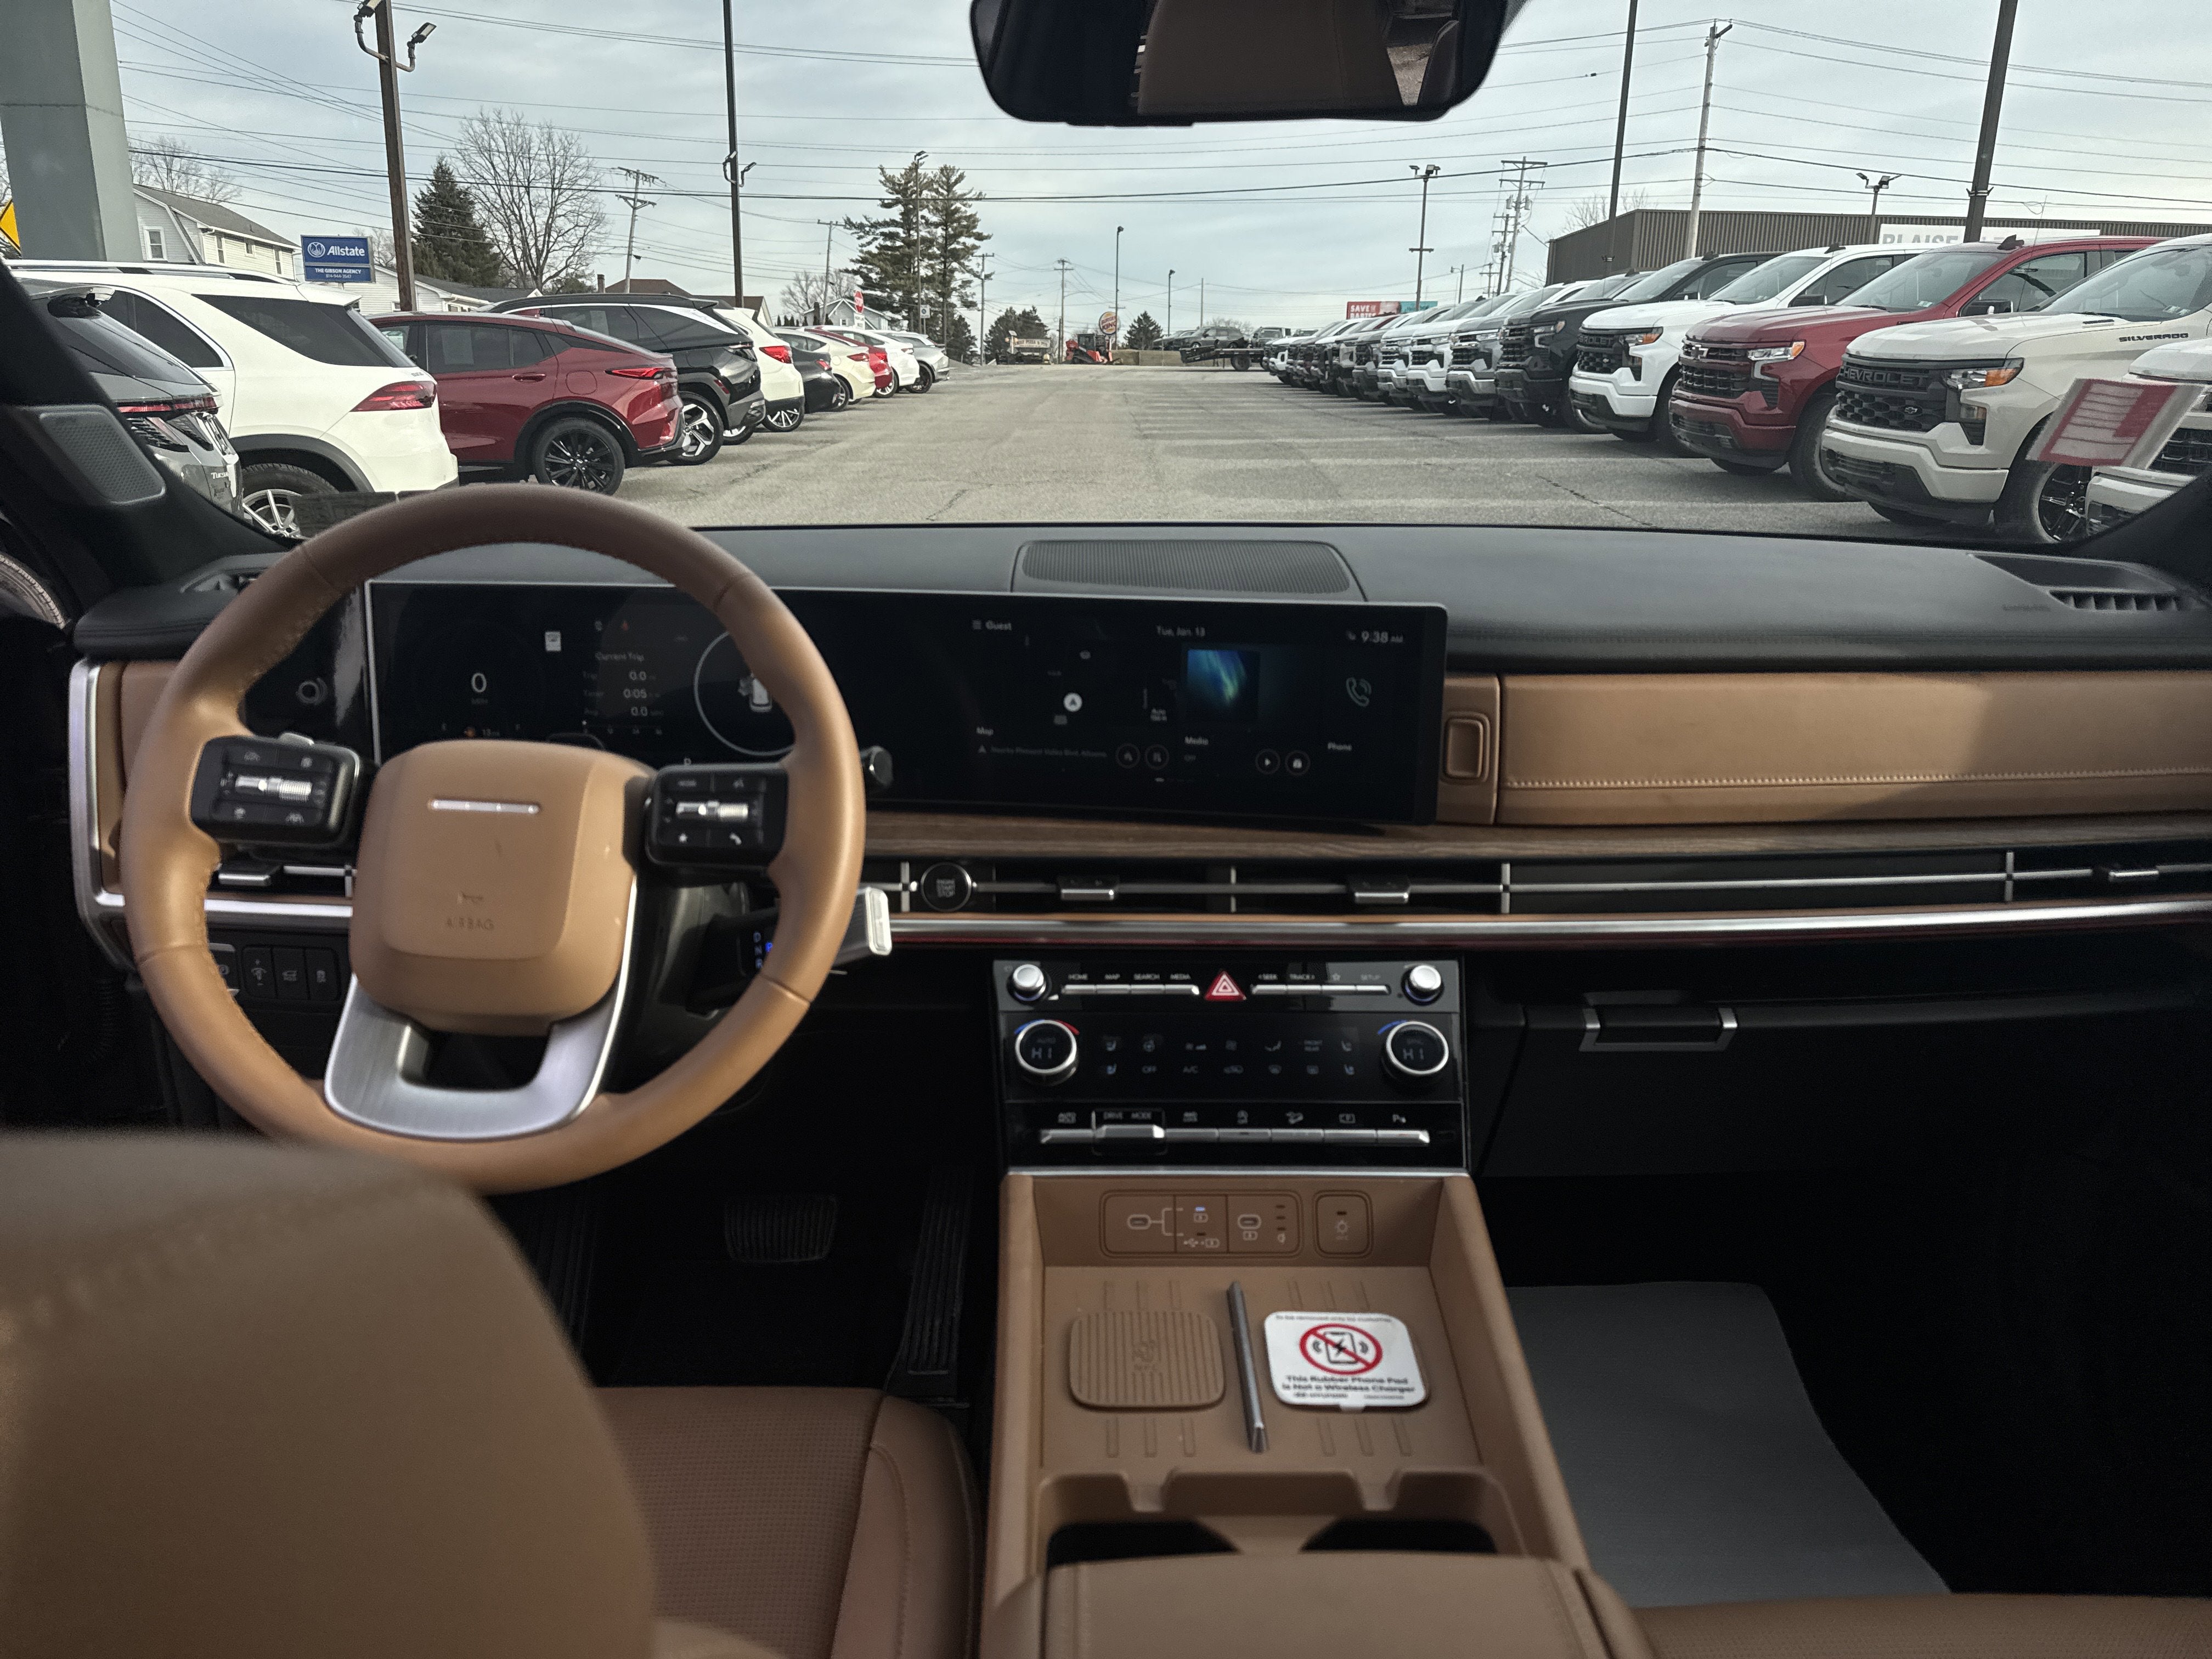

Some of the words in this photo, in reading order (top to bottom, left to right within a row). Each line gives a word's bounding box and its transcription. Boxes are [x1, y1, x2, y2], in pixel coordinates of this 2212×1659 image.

[327, 246, 365, 256] Allstate
[2119, 332, 2188, 342] SILVERADO
[471, 672, 487, 693] 0
[447, 916, 494, 930] AIRBAG
[1371, 1385, 1415, 1394] Charger
